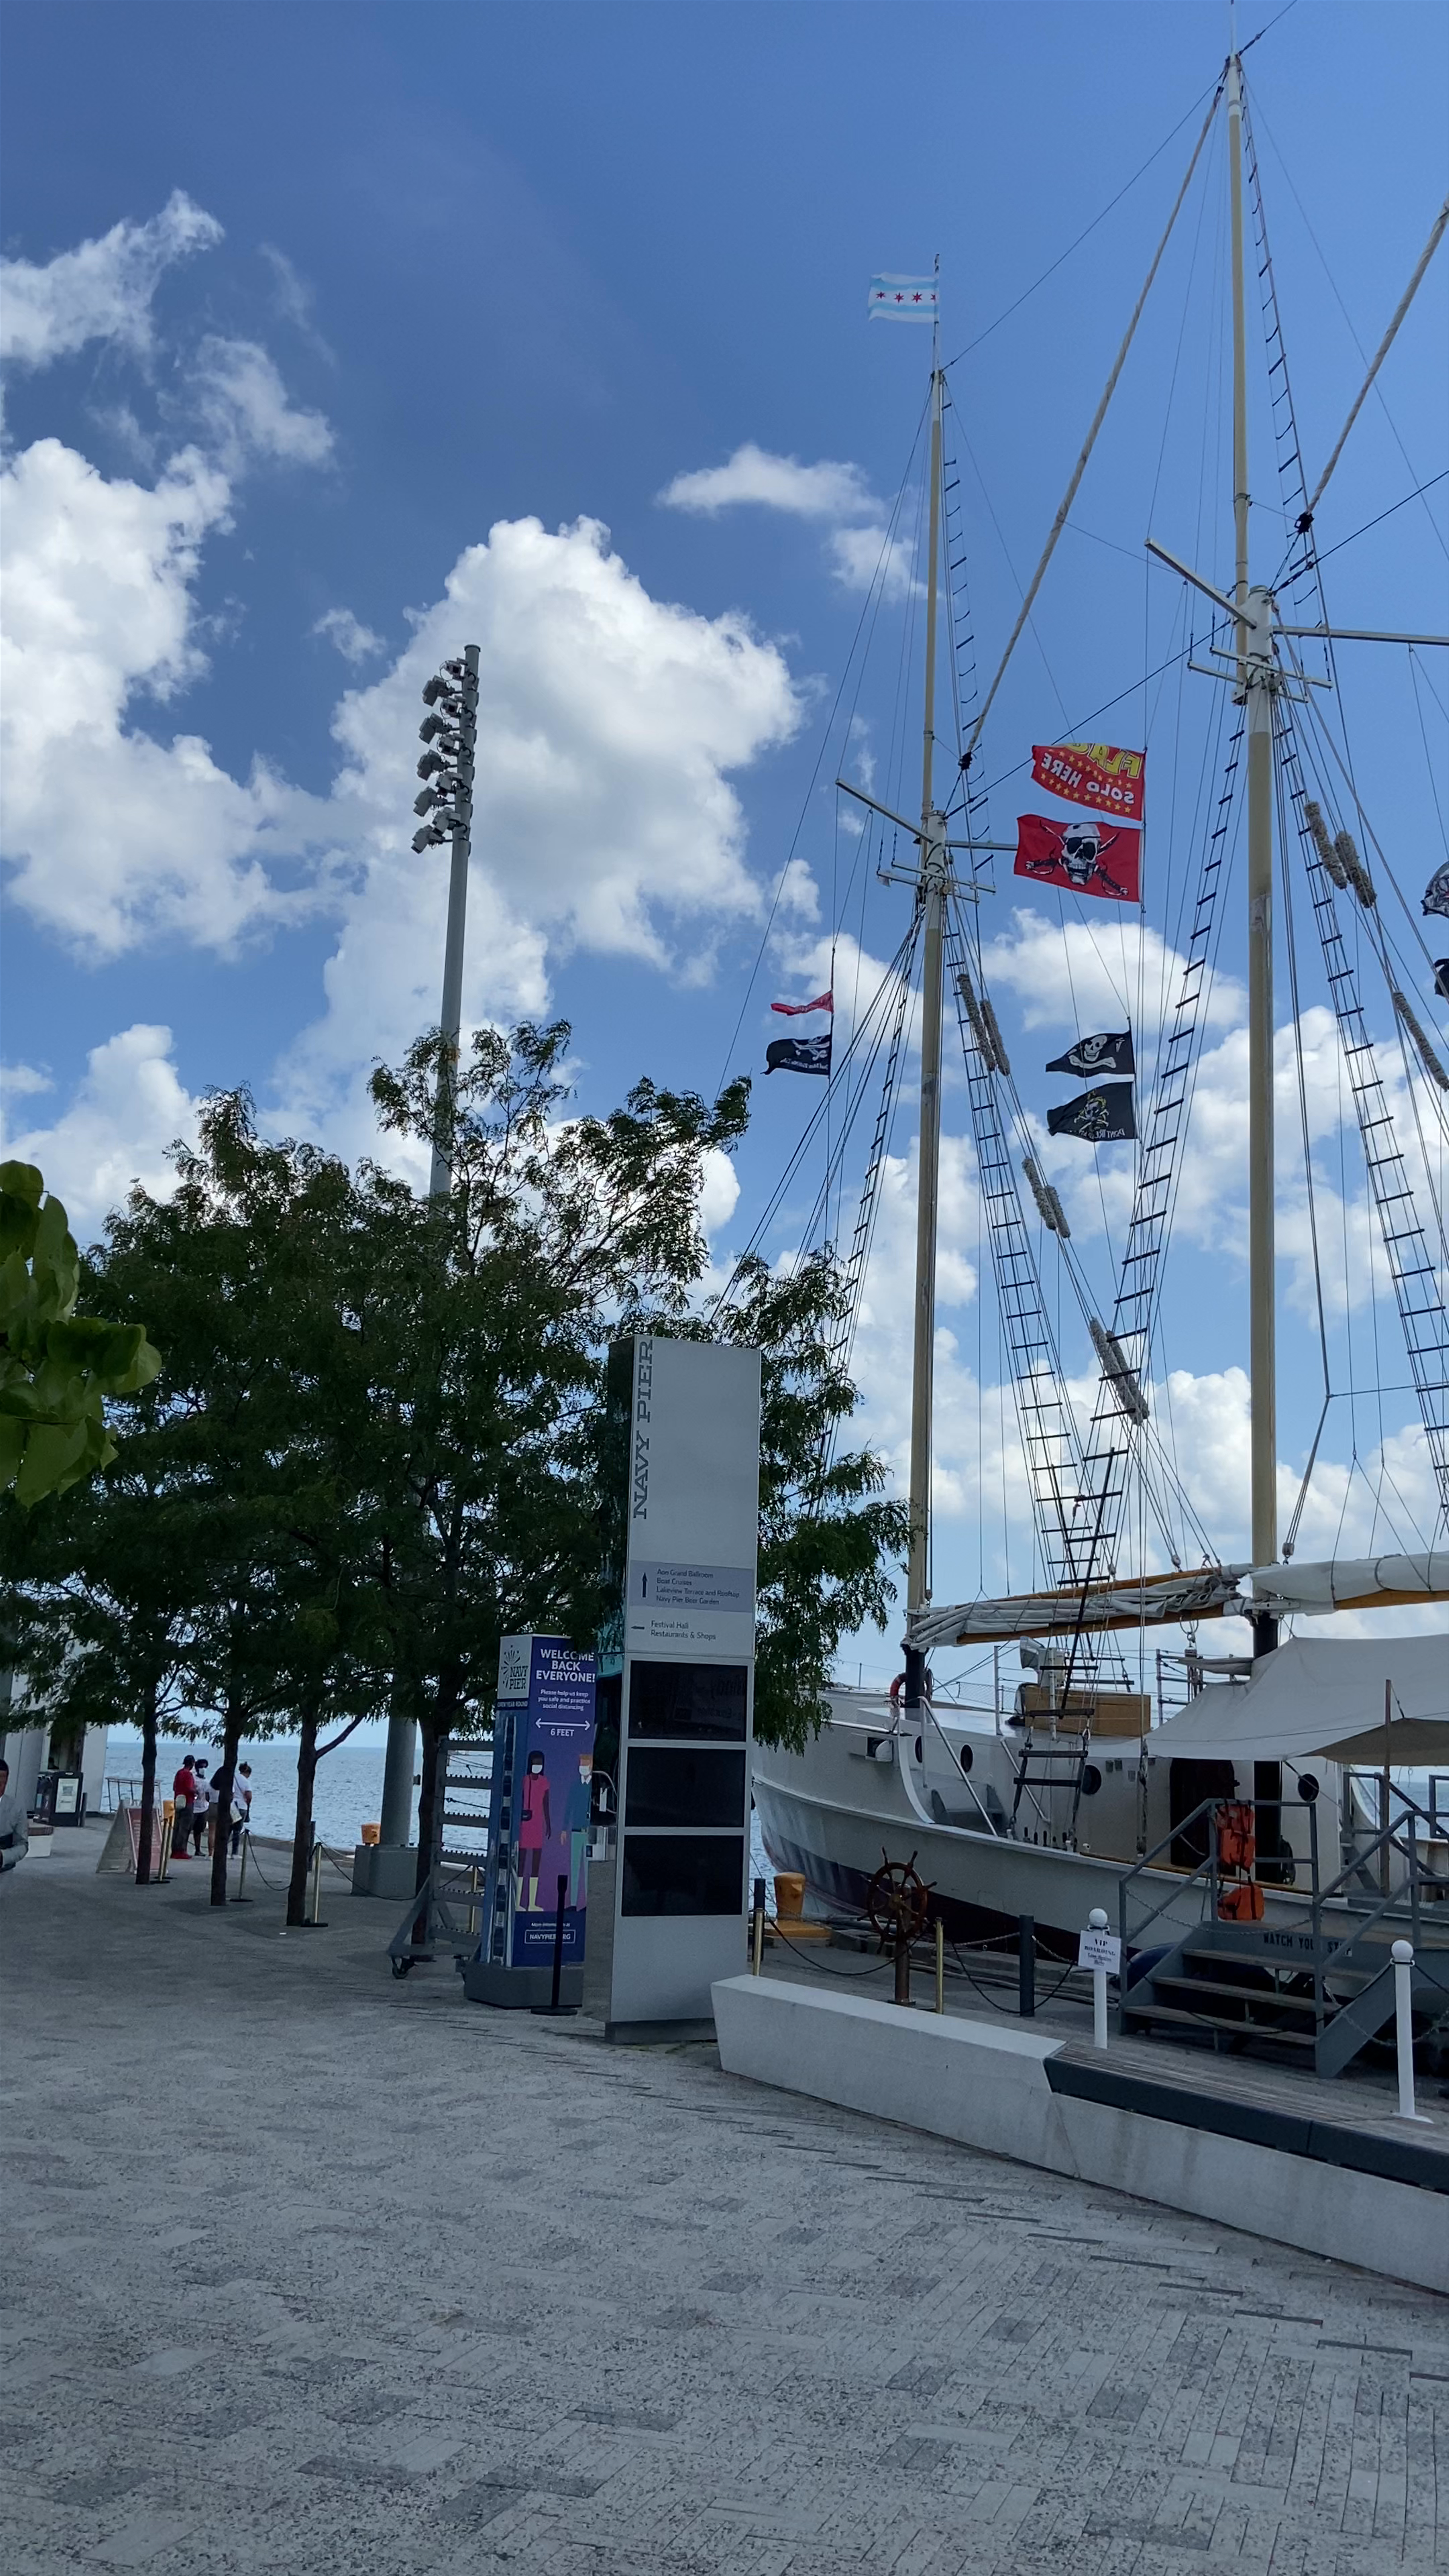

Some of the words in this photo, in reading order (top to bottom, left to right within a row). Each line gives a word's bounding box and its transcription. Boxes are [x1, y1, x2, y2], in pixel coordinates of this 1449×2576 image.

[637, 1339, 653, 1423] PIER
[633, 1430, 649, 1519] NAVY
[717, 1590, 740, 1598] Rooftop
[651, 1630, 688, 1638] Restaurants
[697, 1632, 716, 1641] Shops
[551, 1660, 580, 1671] BACK
[509, 1666, 528, 1678] NAVY
[536, 1670, 596, 1683] EVERYONE!
[509, 1678, 526, 1690] PIER
[1095, 1938, 1108, 1946] VIP
[1264, 1932, 1292, 1947] WATCH
[1084, 1945, 1116, 1956] BOARDING
